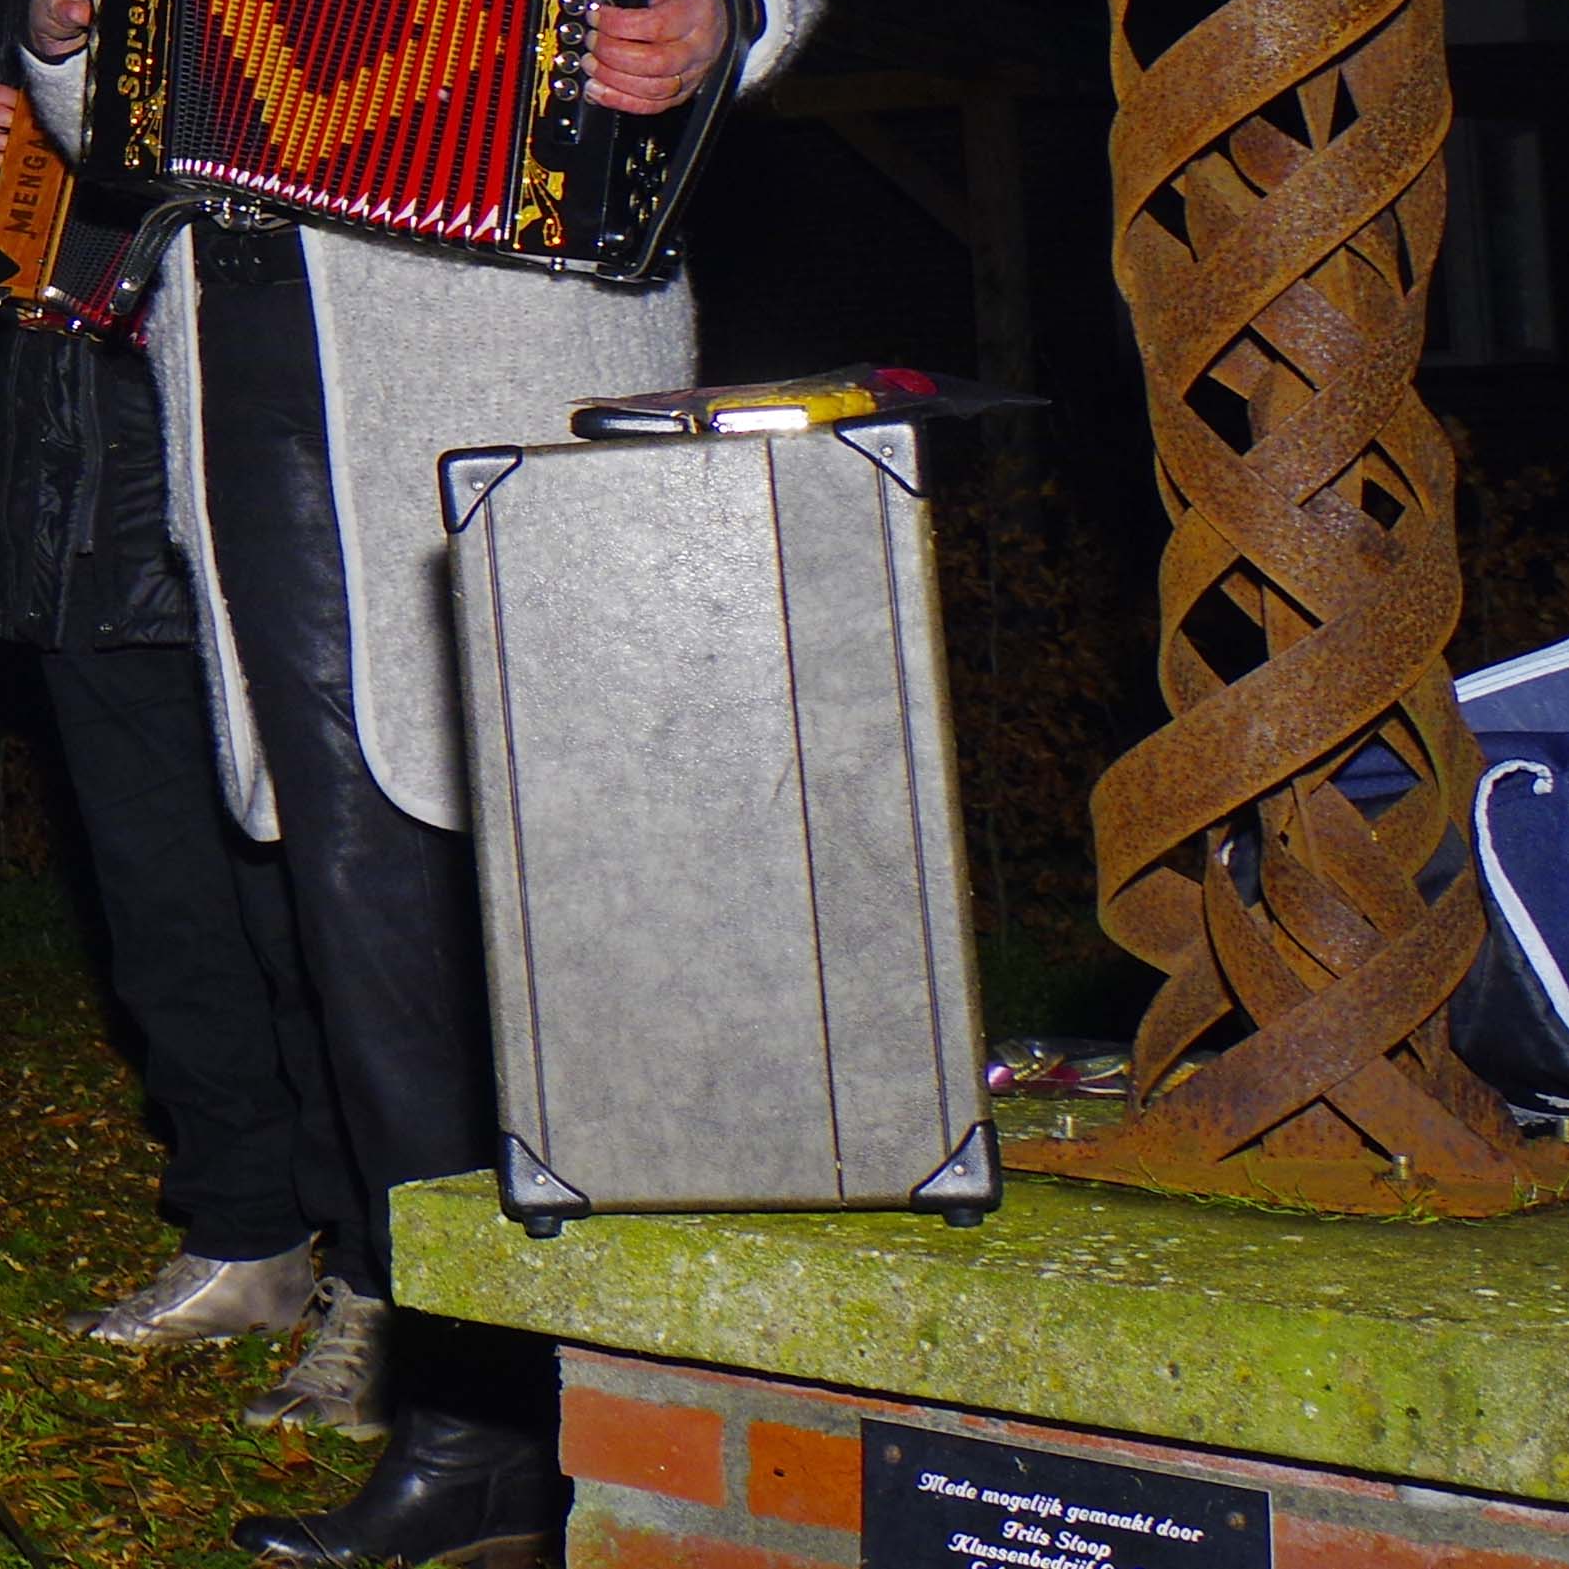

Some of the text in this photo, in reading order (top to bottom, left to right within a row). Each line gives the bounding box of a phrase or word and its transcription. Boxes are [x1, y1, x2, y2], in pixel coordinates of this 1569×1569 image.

[917, 1472, 1205, 1543] Mede mogelijk gemaakt door
[1002, 1519, 1112, 1561] Frits Stoop
